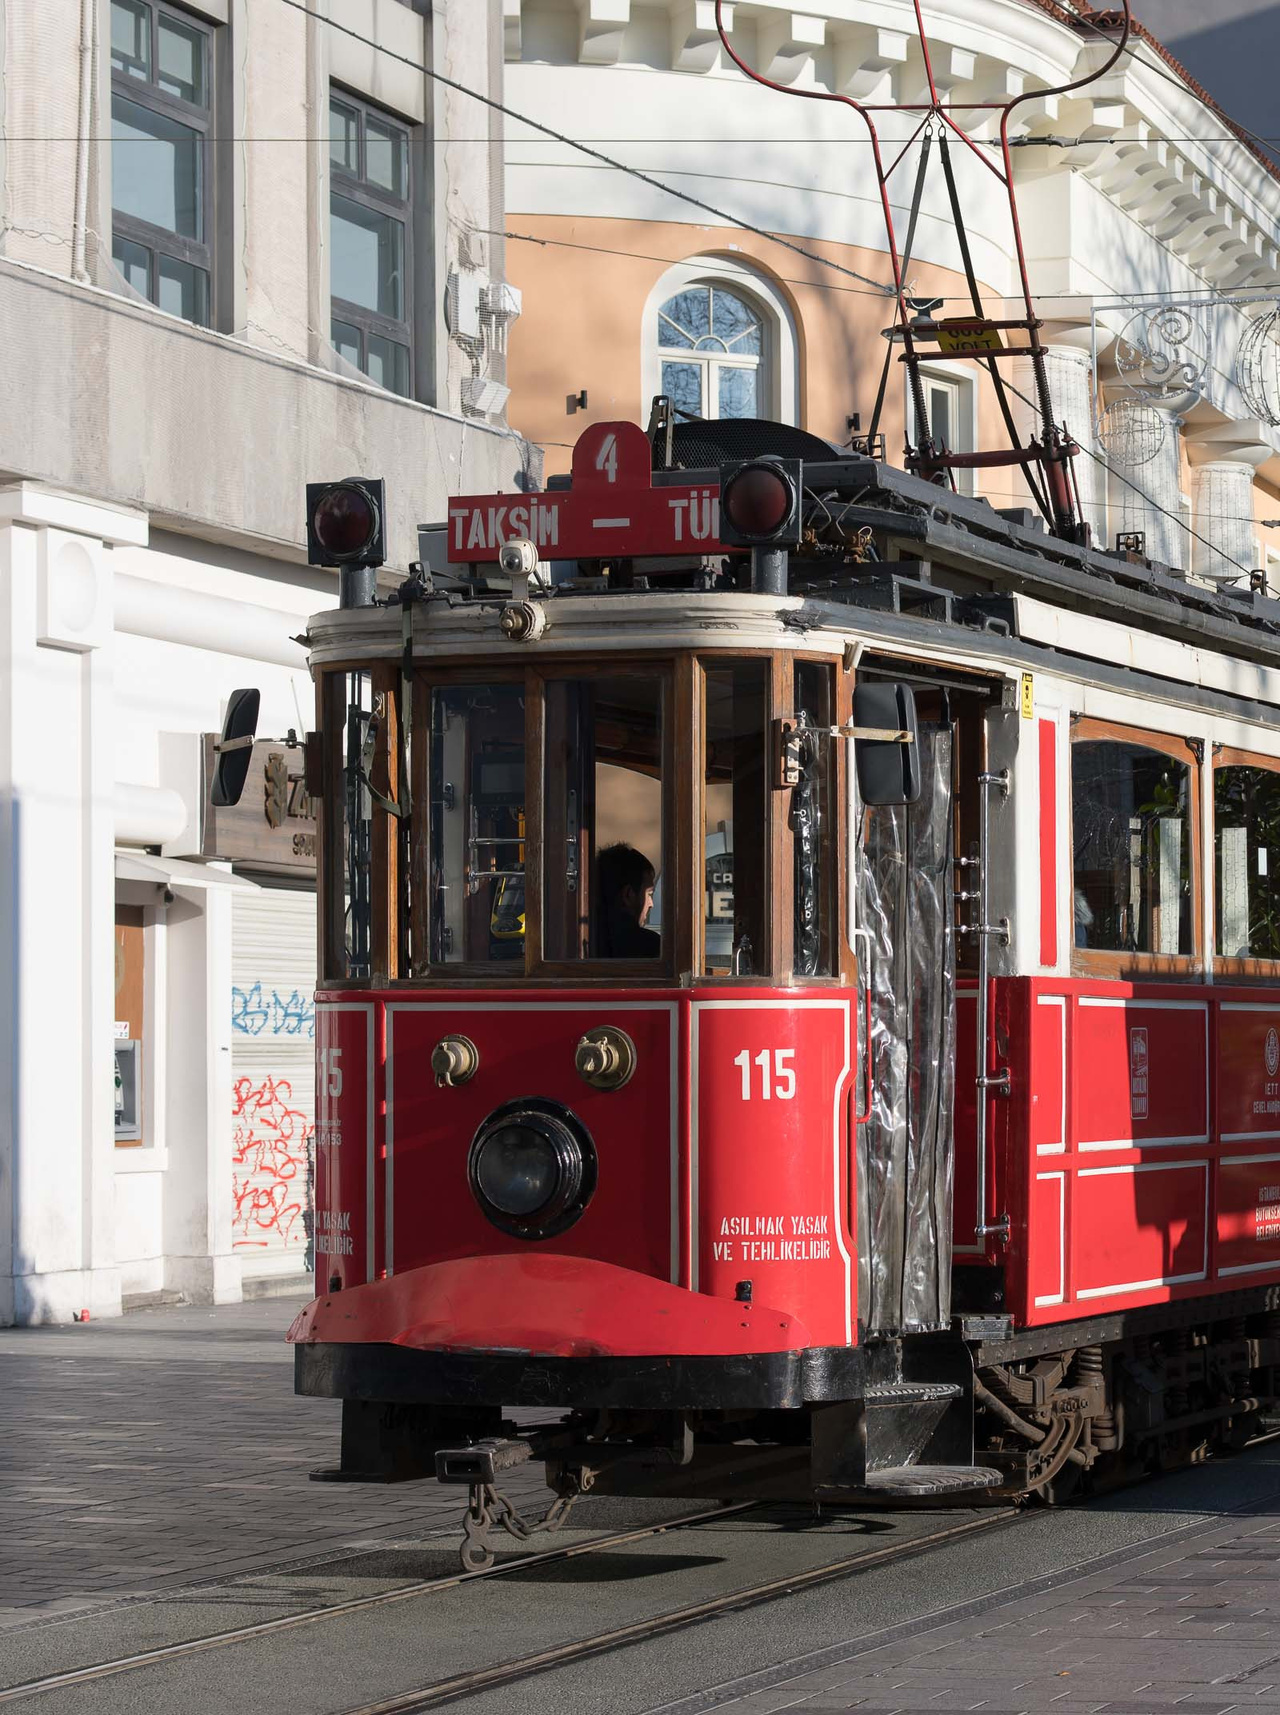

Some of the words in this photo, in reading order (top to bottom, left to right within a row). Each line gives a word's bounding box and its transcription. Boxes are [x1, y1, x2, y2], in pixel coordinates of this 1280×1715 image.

[595, 434, 618, 483] 4
[449, 497, 559, 550] TAKSİM
[734, 1048, 796, 1101] 115
[713, 1242, 733, 1261] VE
[741, 1238, 831, 1261] TEHLİKELİDİR
[720, 1216, 784, 1236] ASILMAK
[791, 1215, 828, 1235] YASAK
